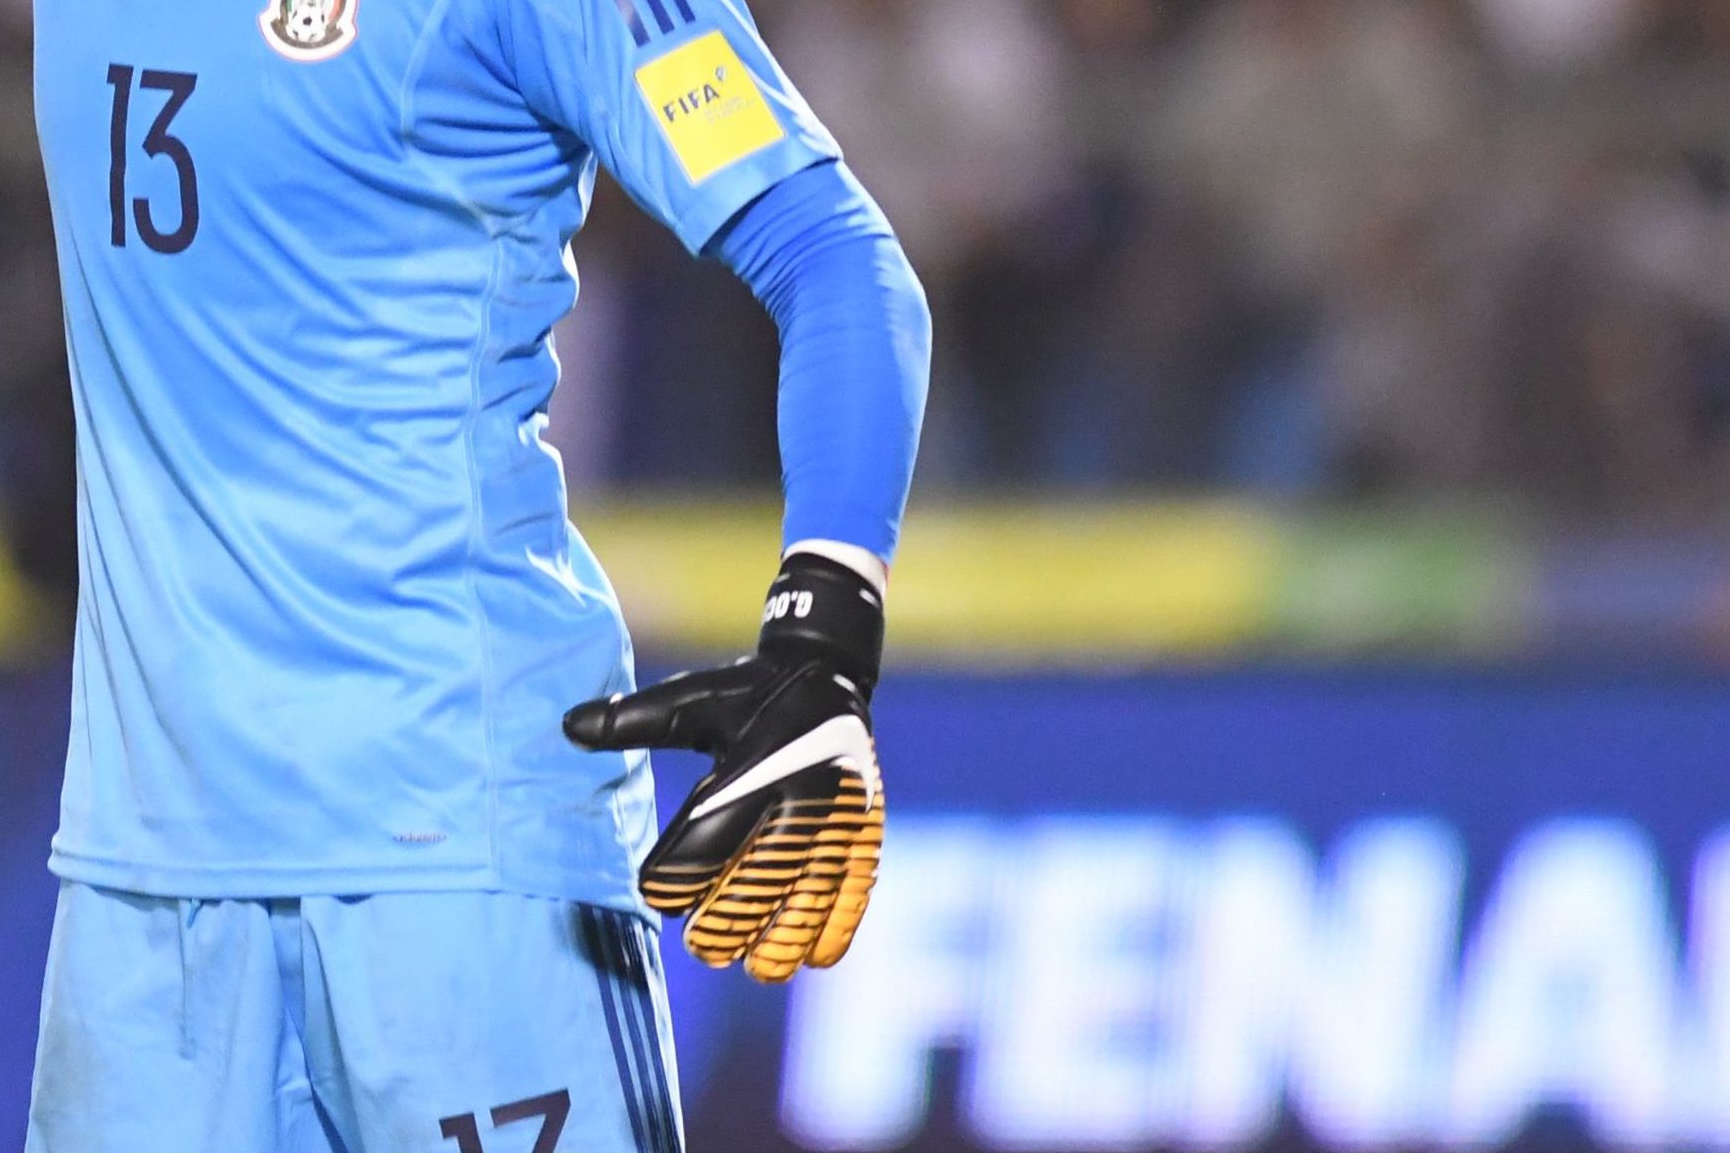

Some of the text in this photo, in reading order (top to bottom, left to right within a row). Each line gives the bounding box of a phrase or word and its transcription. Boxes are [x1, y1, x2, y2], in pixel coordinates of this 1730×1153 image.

[106, 62, 200, 255] 13
[663, 84, 720, 123] FIFA
[780, 816, 1730, 1150] FENA
